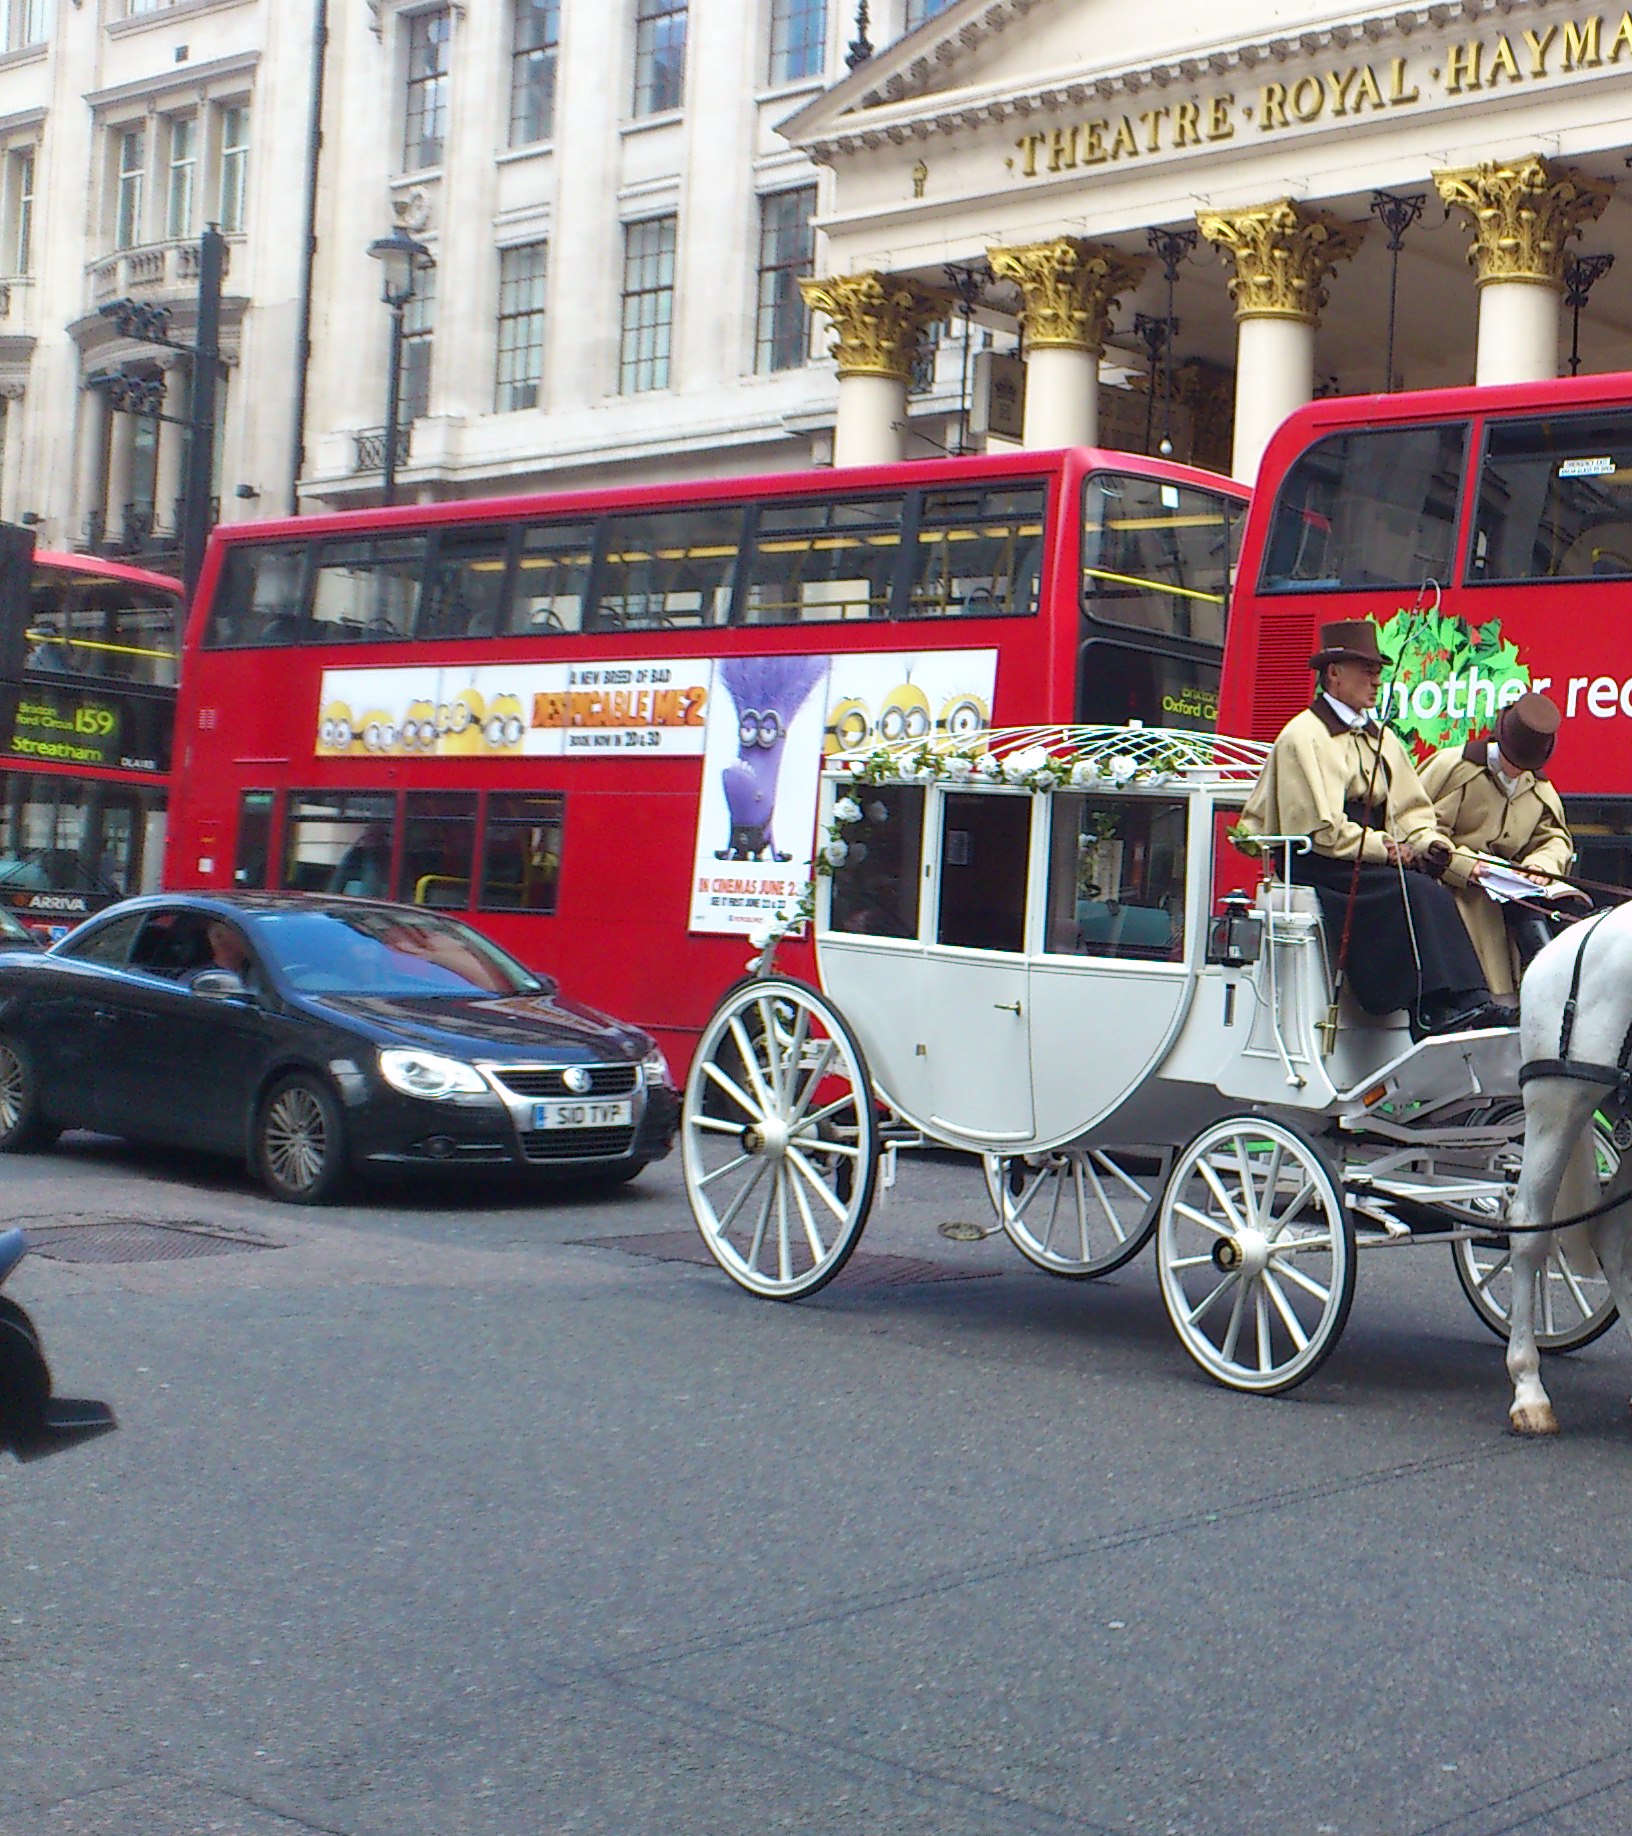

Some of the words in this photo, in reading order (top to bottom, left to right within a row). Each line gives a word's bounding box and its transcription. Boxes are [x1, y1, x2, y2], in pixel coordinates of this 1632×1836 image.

[1015, 94, 1234, 176] THEATRE
[1258, 56, 1419, 131] ROYAL
[1367, 666, 1551, 719] nother
[532, 690, 650, 727] DESPICABLE
[1162, 696, 1202, 717] Oxford
[75, 708, 115, 735] 159
[11, 735, 103, 761] Streatham
[712, 878, 757, 894] CINEMAS
[758, 880, 785, 895] JUNE
[28, 896, 87, 911] ARRIVA
